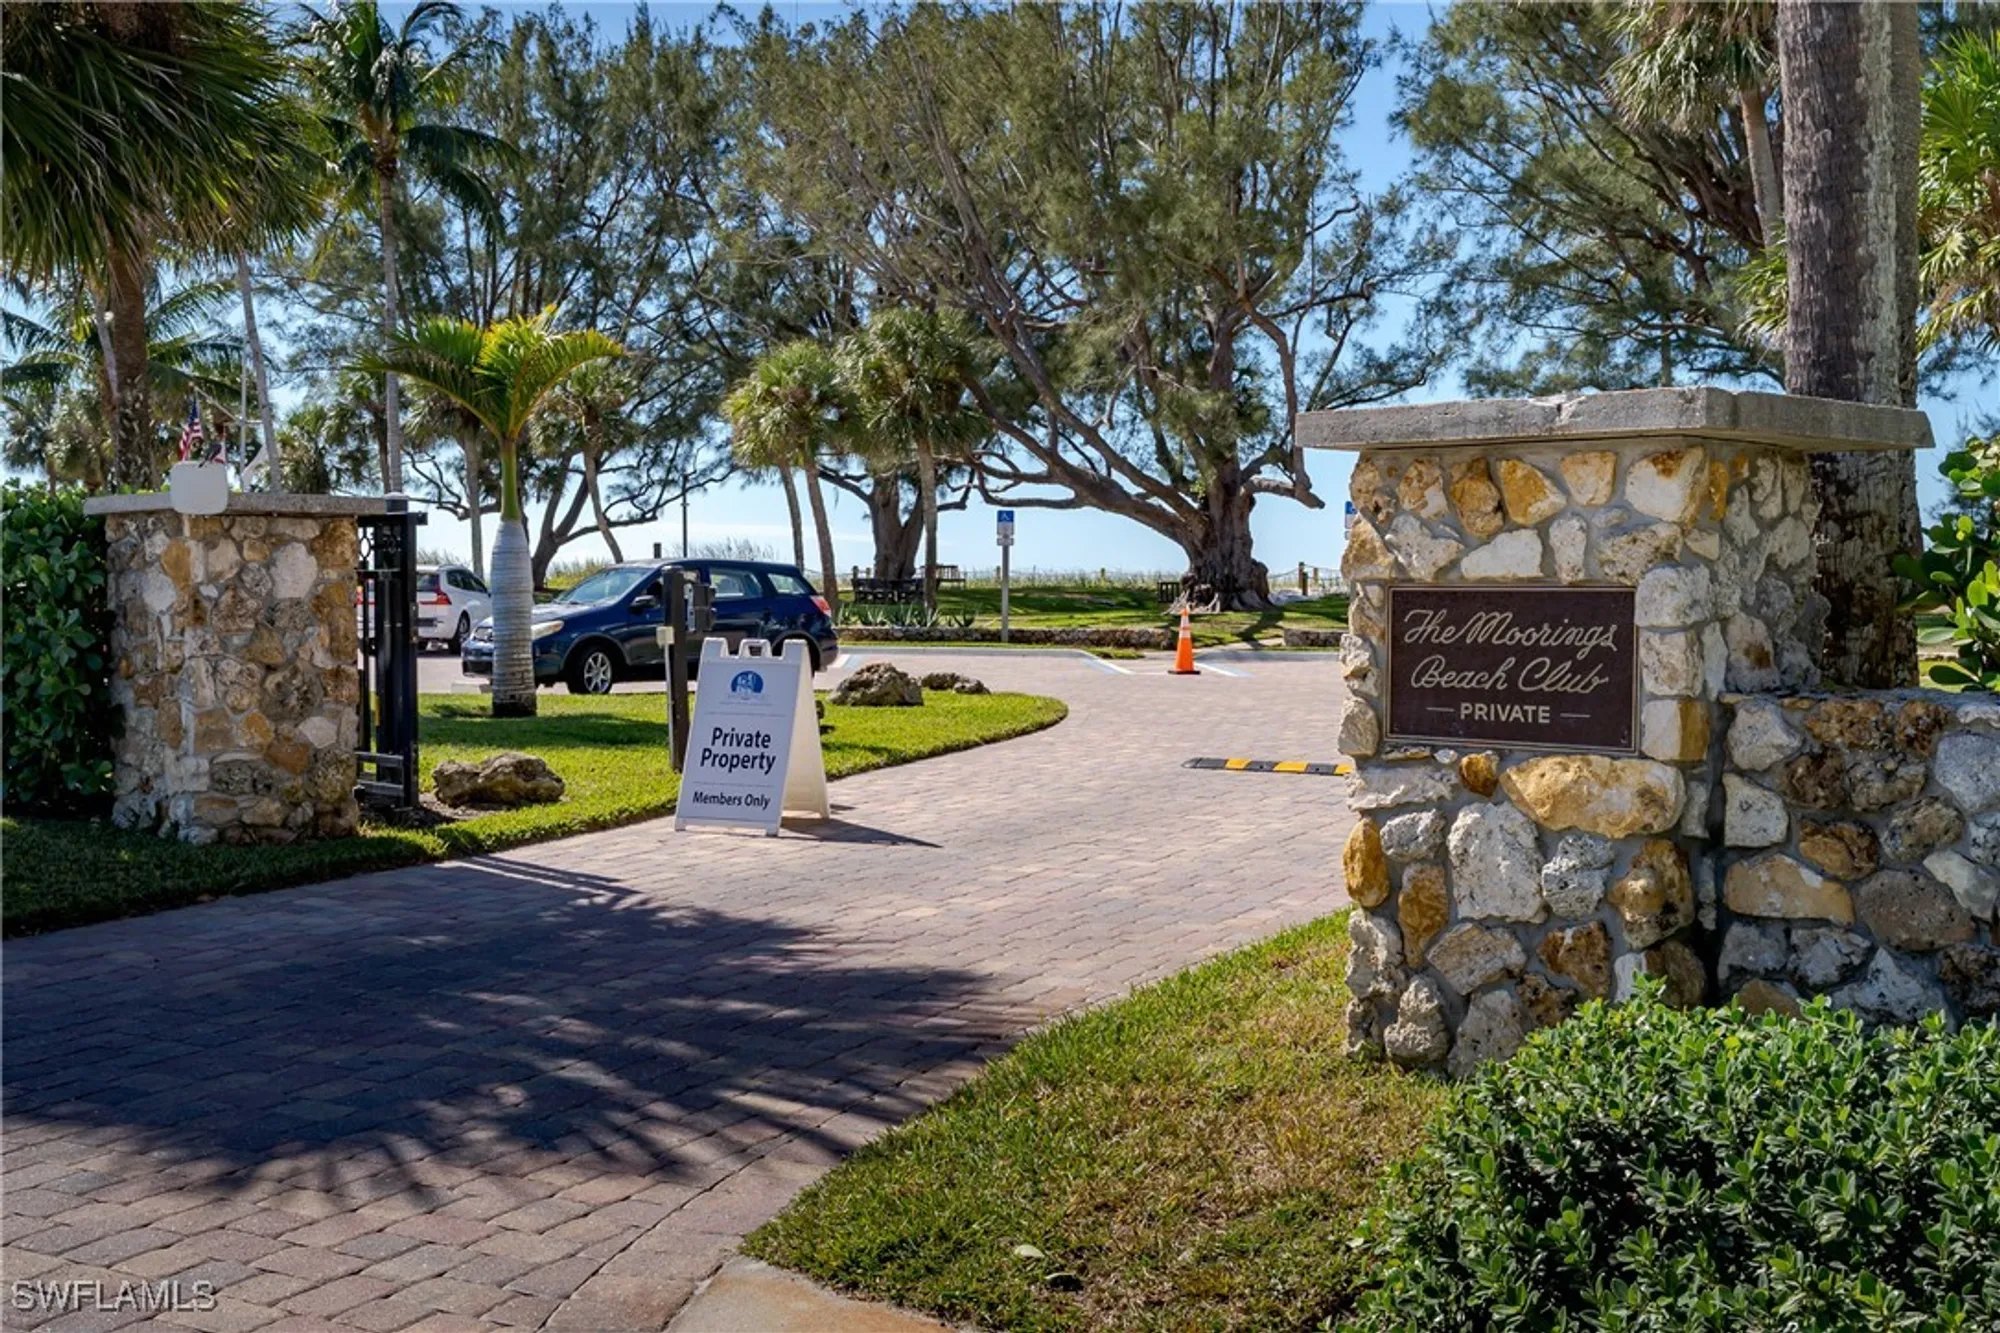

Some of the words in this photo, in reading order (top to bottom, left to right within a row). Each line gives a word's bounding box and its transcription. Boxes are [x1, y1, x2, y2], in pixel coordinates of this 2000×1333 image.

[1403, 608, 1458, 644] The
[1465, 611, 1618, 660] Moorings
[1410, 654, 1516, 690] Beach
[1517, 657, 1609, 694] Club
[1459, 703, 1551, 723] PRIVATE
[711, 727, 772, 749] Private
[699, 747, 777, 775] Property
[692, 791, 742, 807] Members
[744, 794, 770, 810] Only
